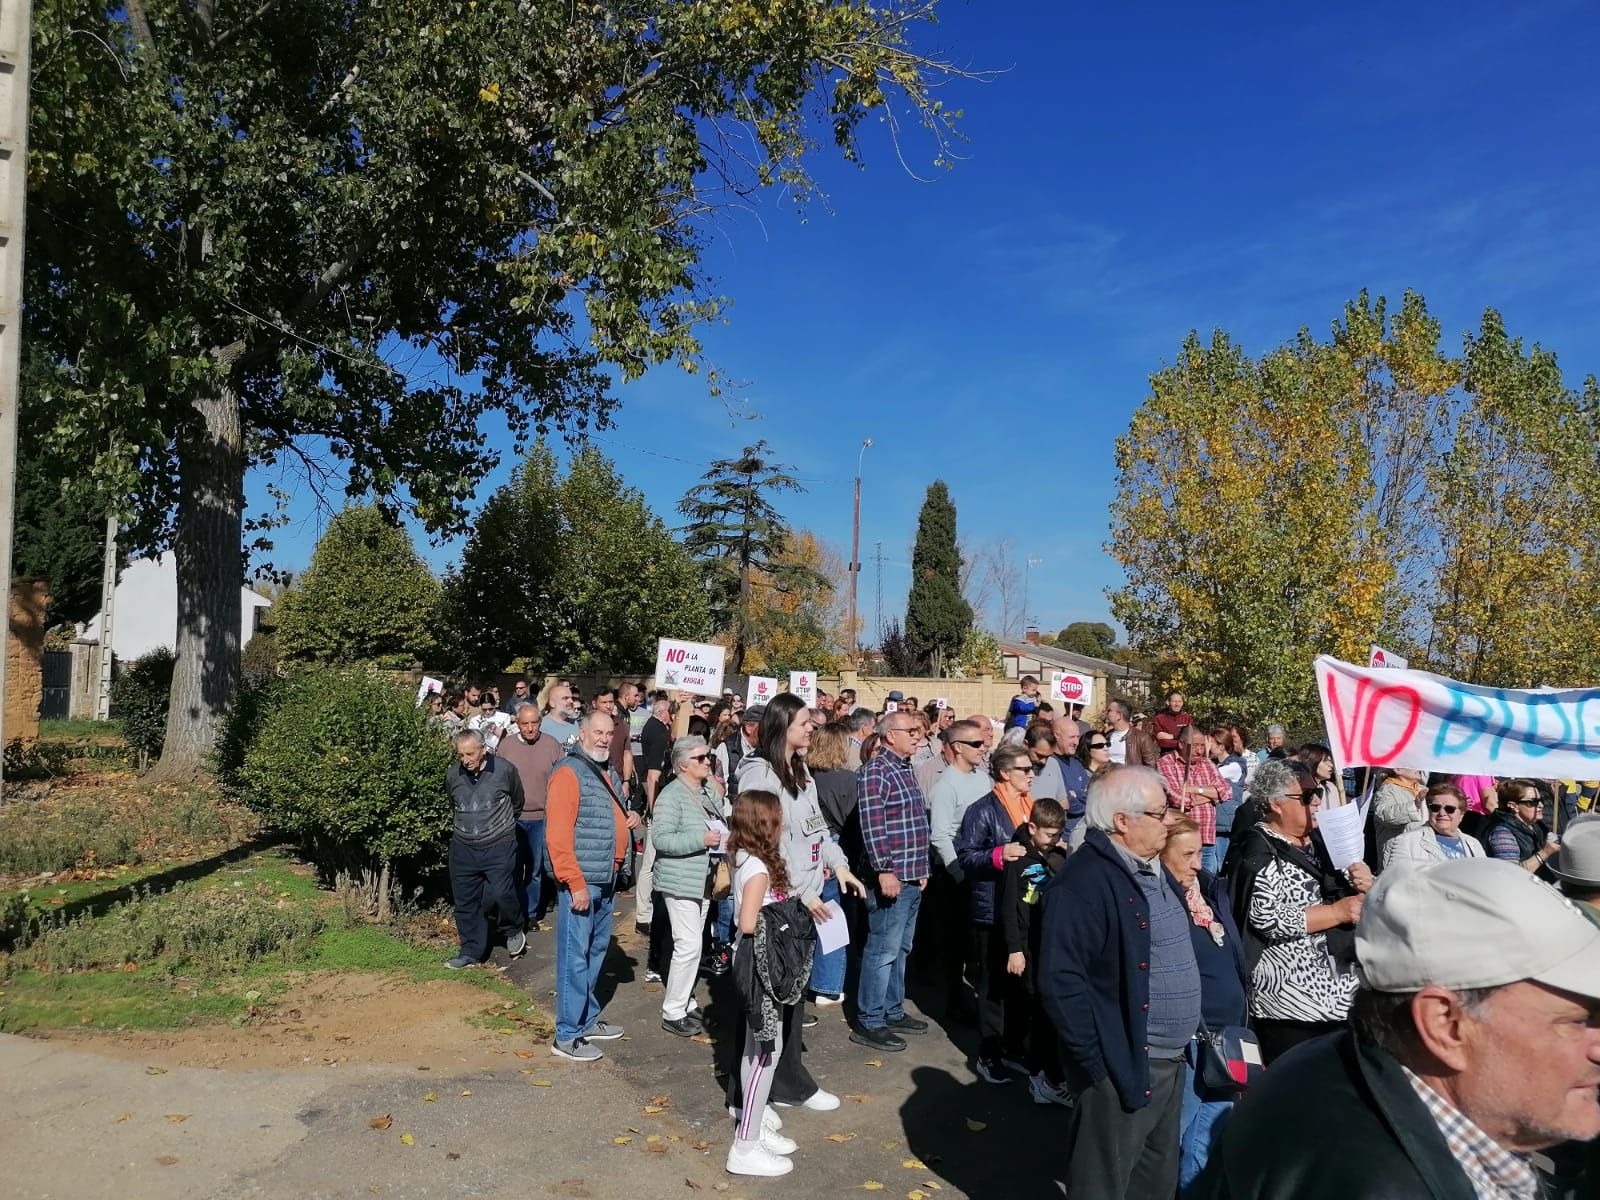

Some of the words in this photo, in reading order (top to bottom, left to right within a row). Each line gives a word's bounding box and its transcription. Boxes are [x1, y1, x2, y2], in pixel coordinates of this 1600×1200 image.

[666, 648, 686, 663] NO
[684, 664, 706, 674] PLANTA
[1062, 681, 1082, 693] STOP
